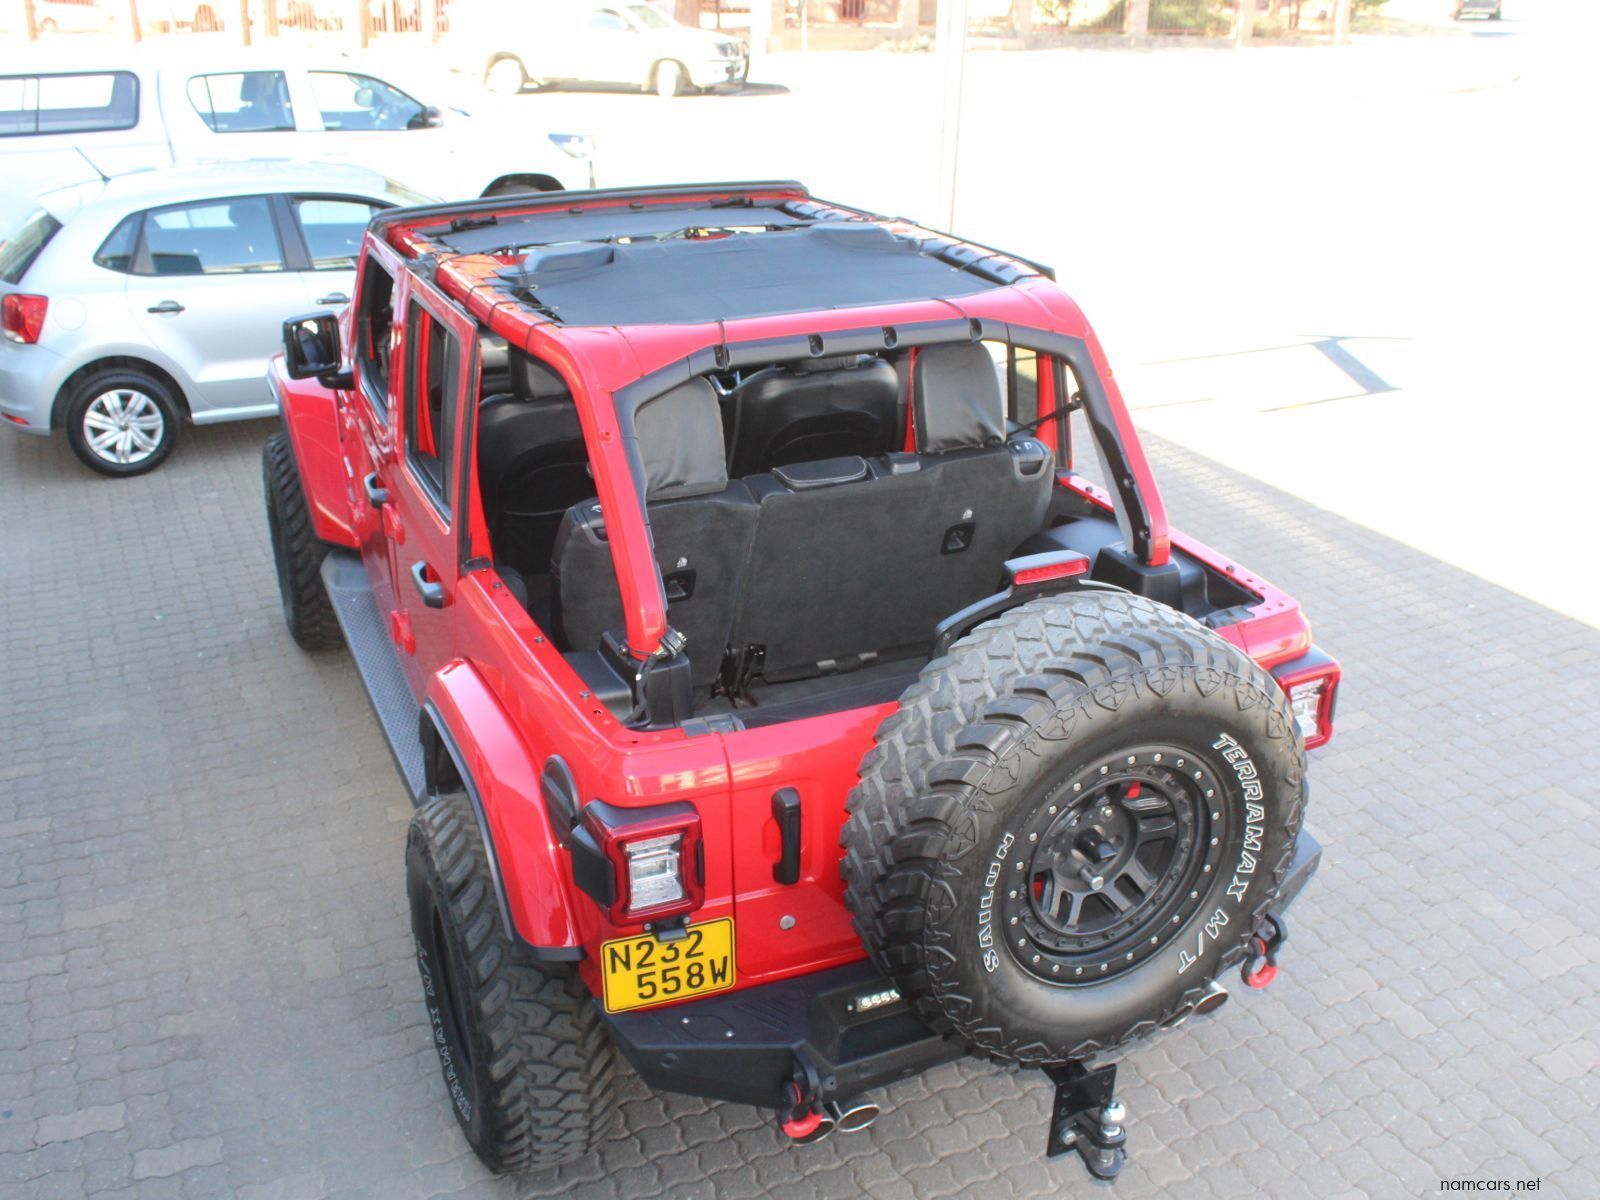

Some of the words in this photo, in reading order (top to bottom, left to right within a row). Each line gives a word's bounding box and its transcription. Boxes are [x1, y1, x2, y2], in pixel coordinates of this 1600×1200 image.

[1212, 732, 1265, 902] TERRAMAX
[978, 832, 1015, 972] SAILUN
[609, 930, 704, 974] N232
[1178, 908, 1229, 974] M/T
[637, 956, 728, 1000] 558W
